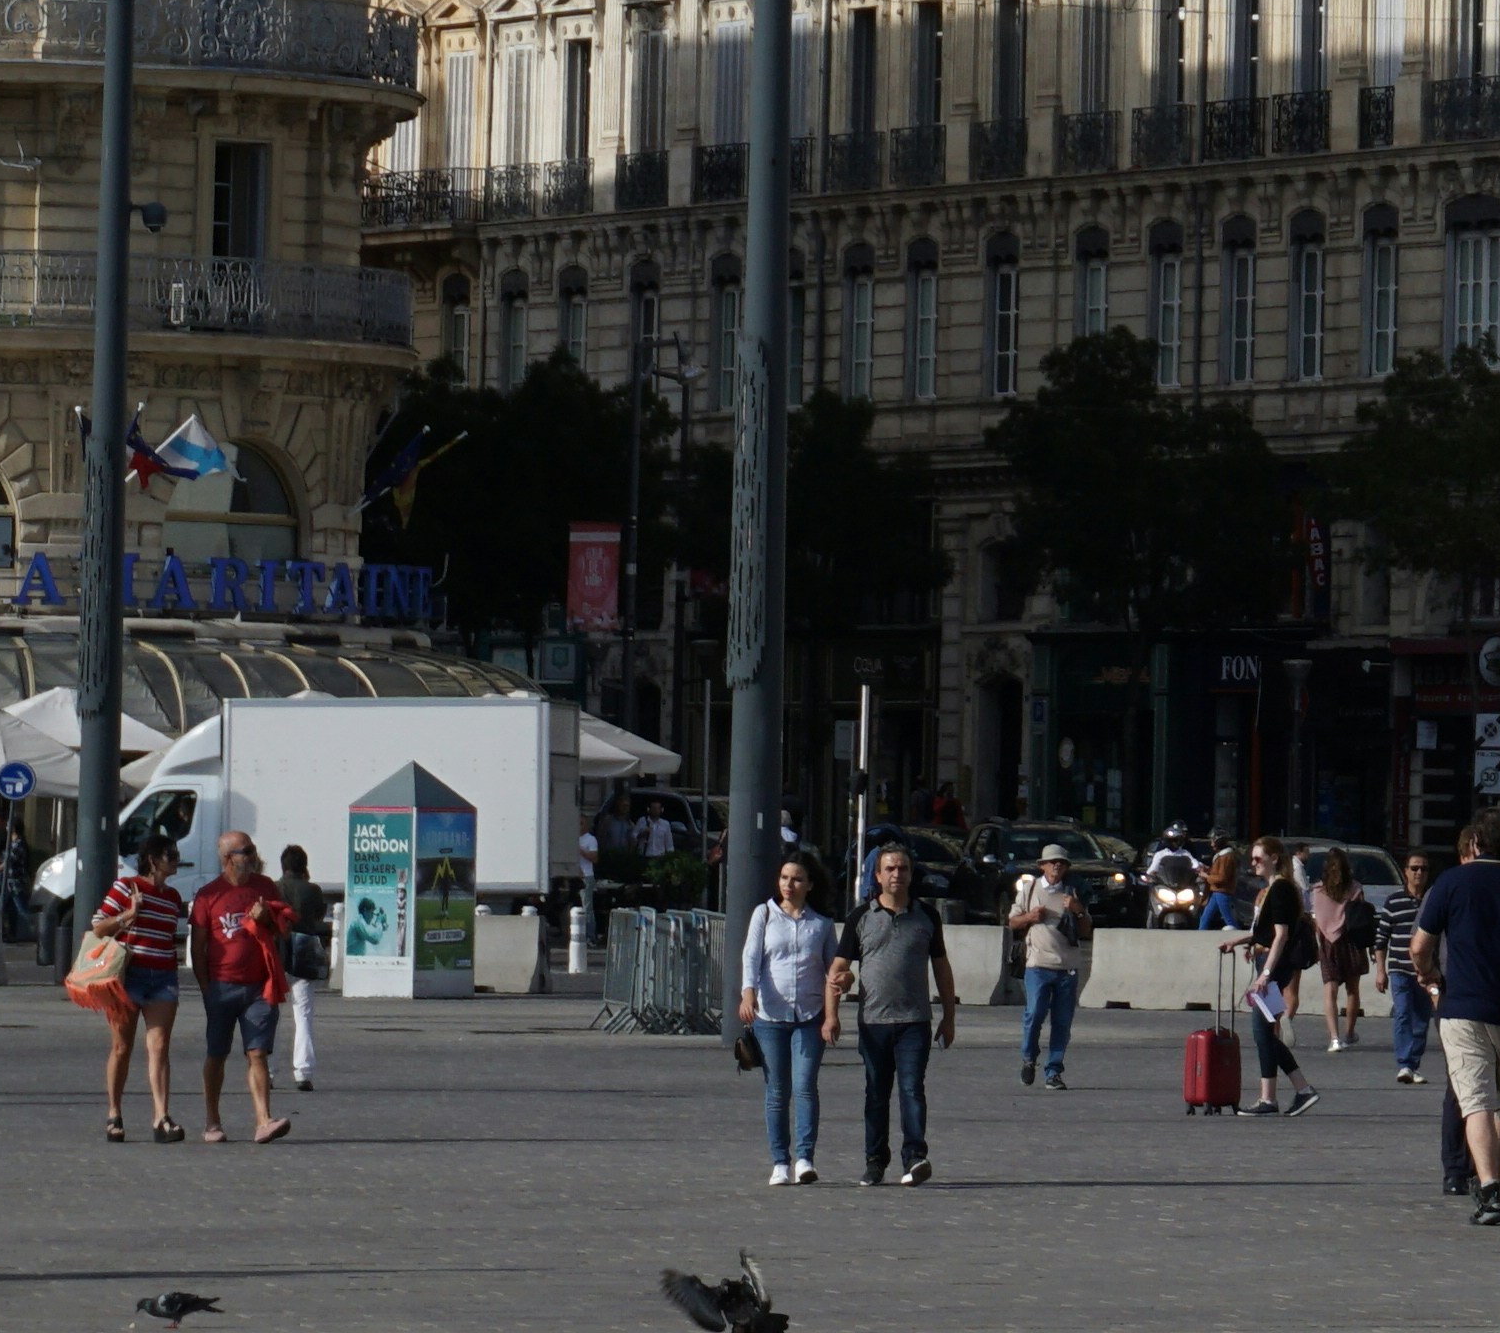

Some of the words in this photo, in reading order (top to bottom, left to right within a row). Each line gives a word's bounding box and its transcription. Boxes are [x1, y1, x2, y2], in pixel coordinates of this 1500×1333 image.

[1310, 519, 1324, 587] ABAC
[1485, 772, 1496, 782] 30
[354, 824, 386, 838] JACK
[354, 839, 409, 853] LONDON
[354, 852, 381, 863] DANS
[354, 863, 371, 874] LES
[372, 864, 397, 875] MERS
[353, 875, 368, 885] DU
[369, 875, 388, 885] SUD
